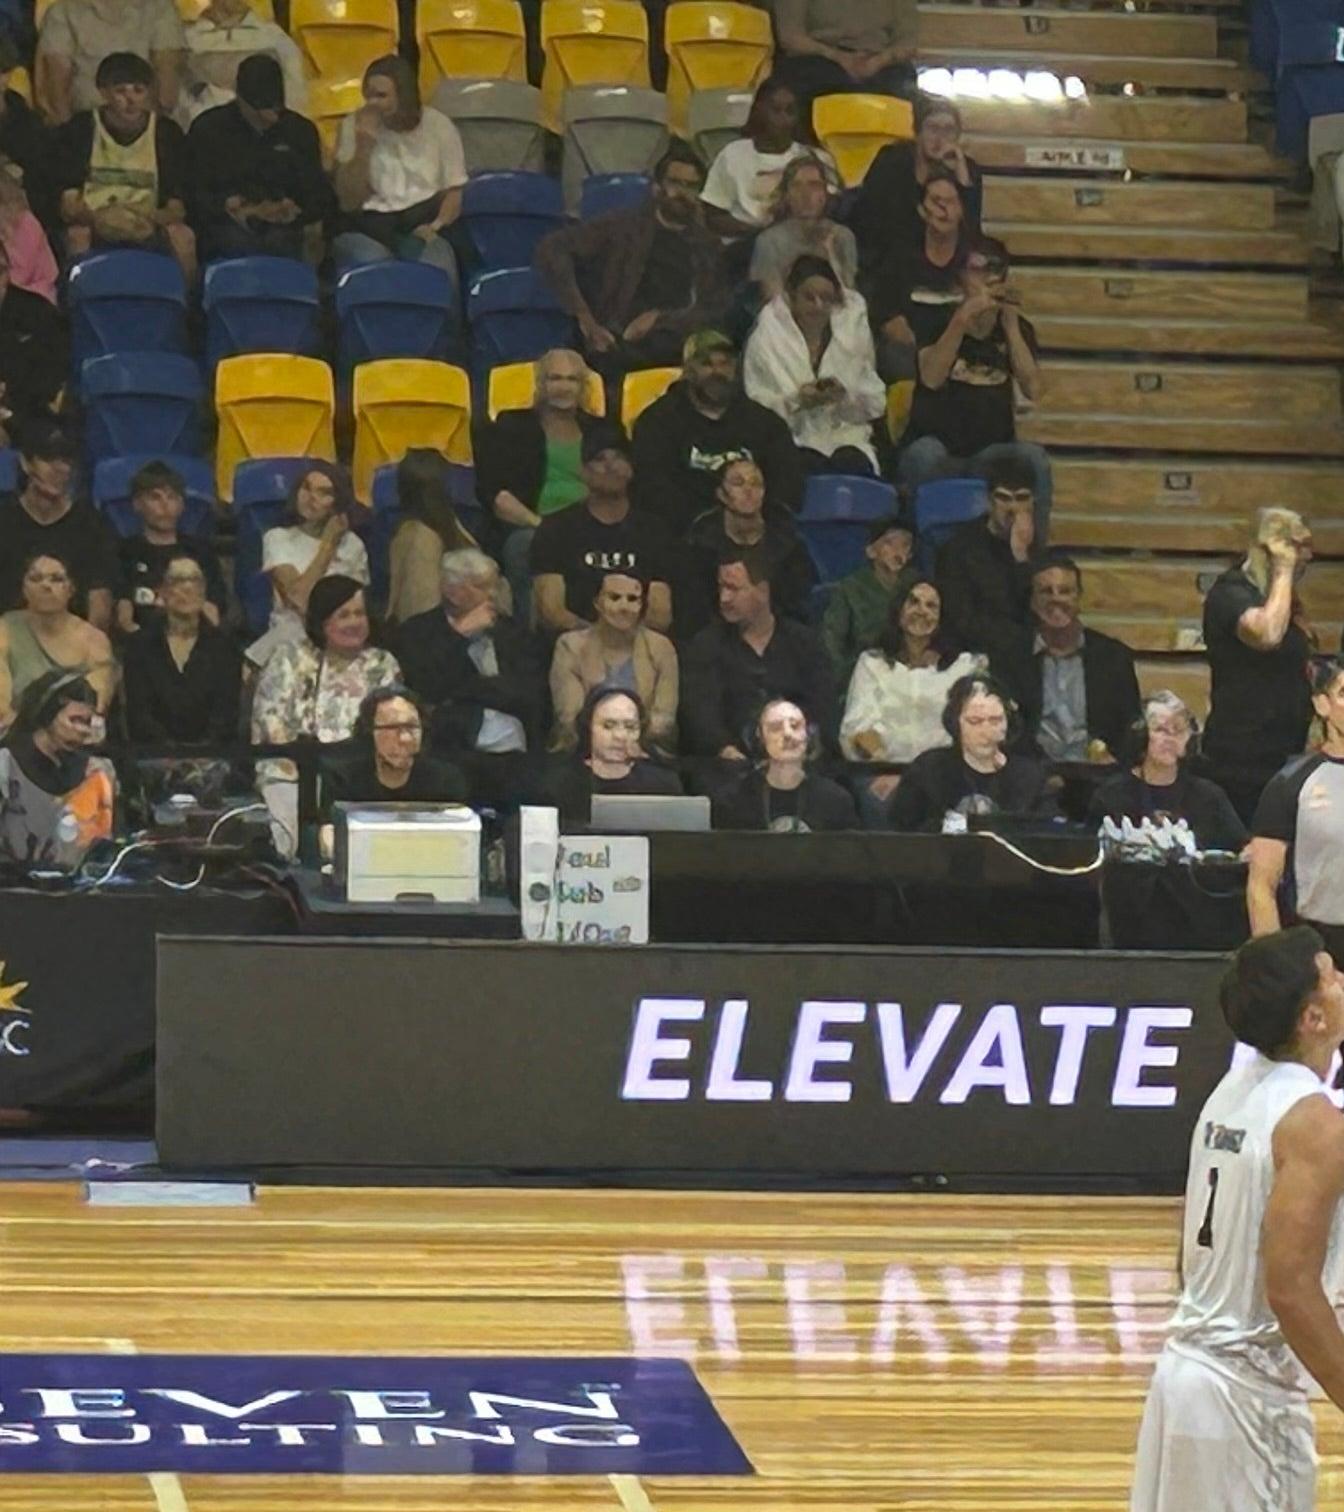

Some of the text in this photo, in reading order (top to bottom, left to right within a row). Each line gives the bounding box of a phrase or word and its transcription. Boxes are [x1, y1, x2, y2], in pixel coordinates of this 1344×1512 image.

[621, 998, 1194, 1107] ELEVATE
[1197, 1167, 1213, 1248] 1
[0, 1383, 621, 1419] EVEN
